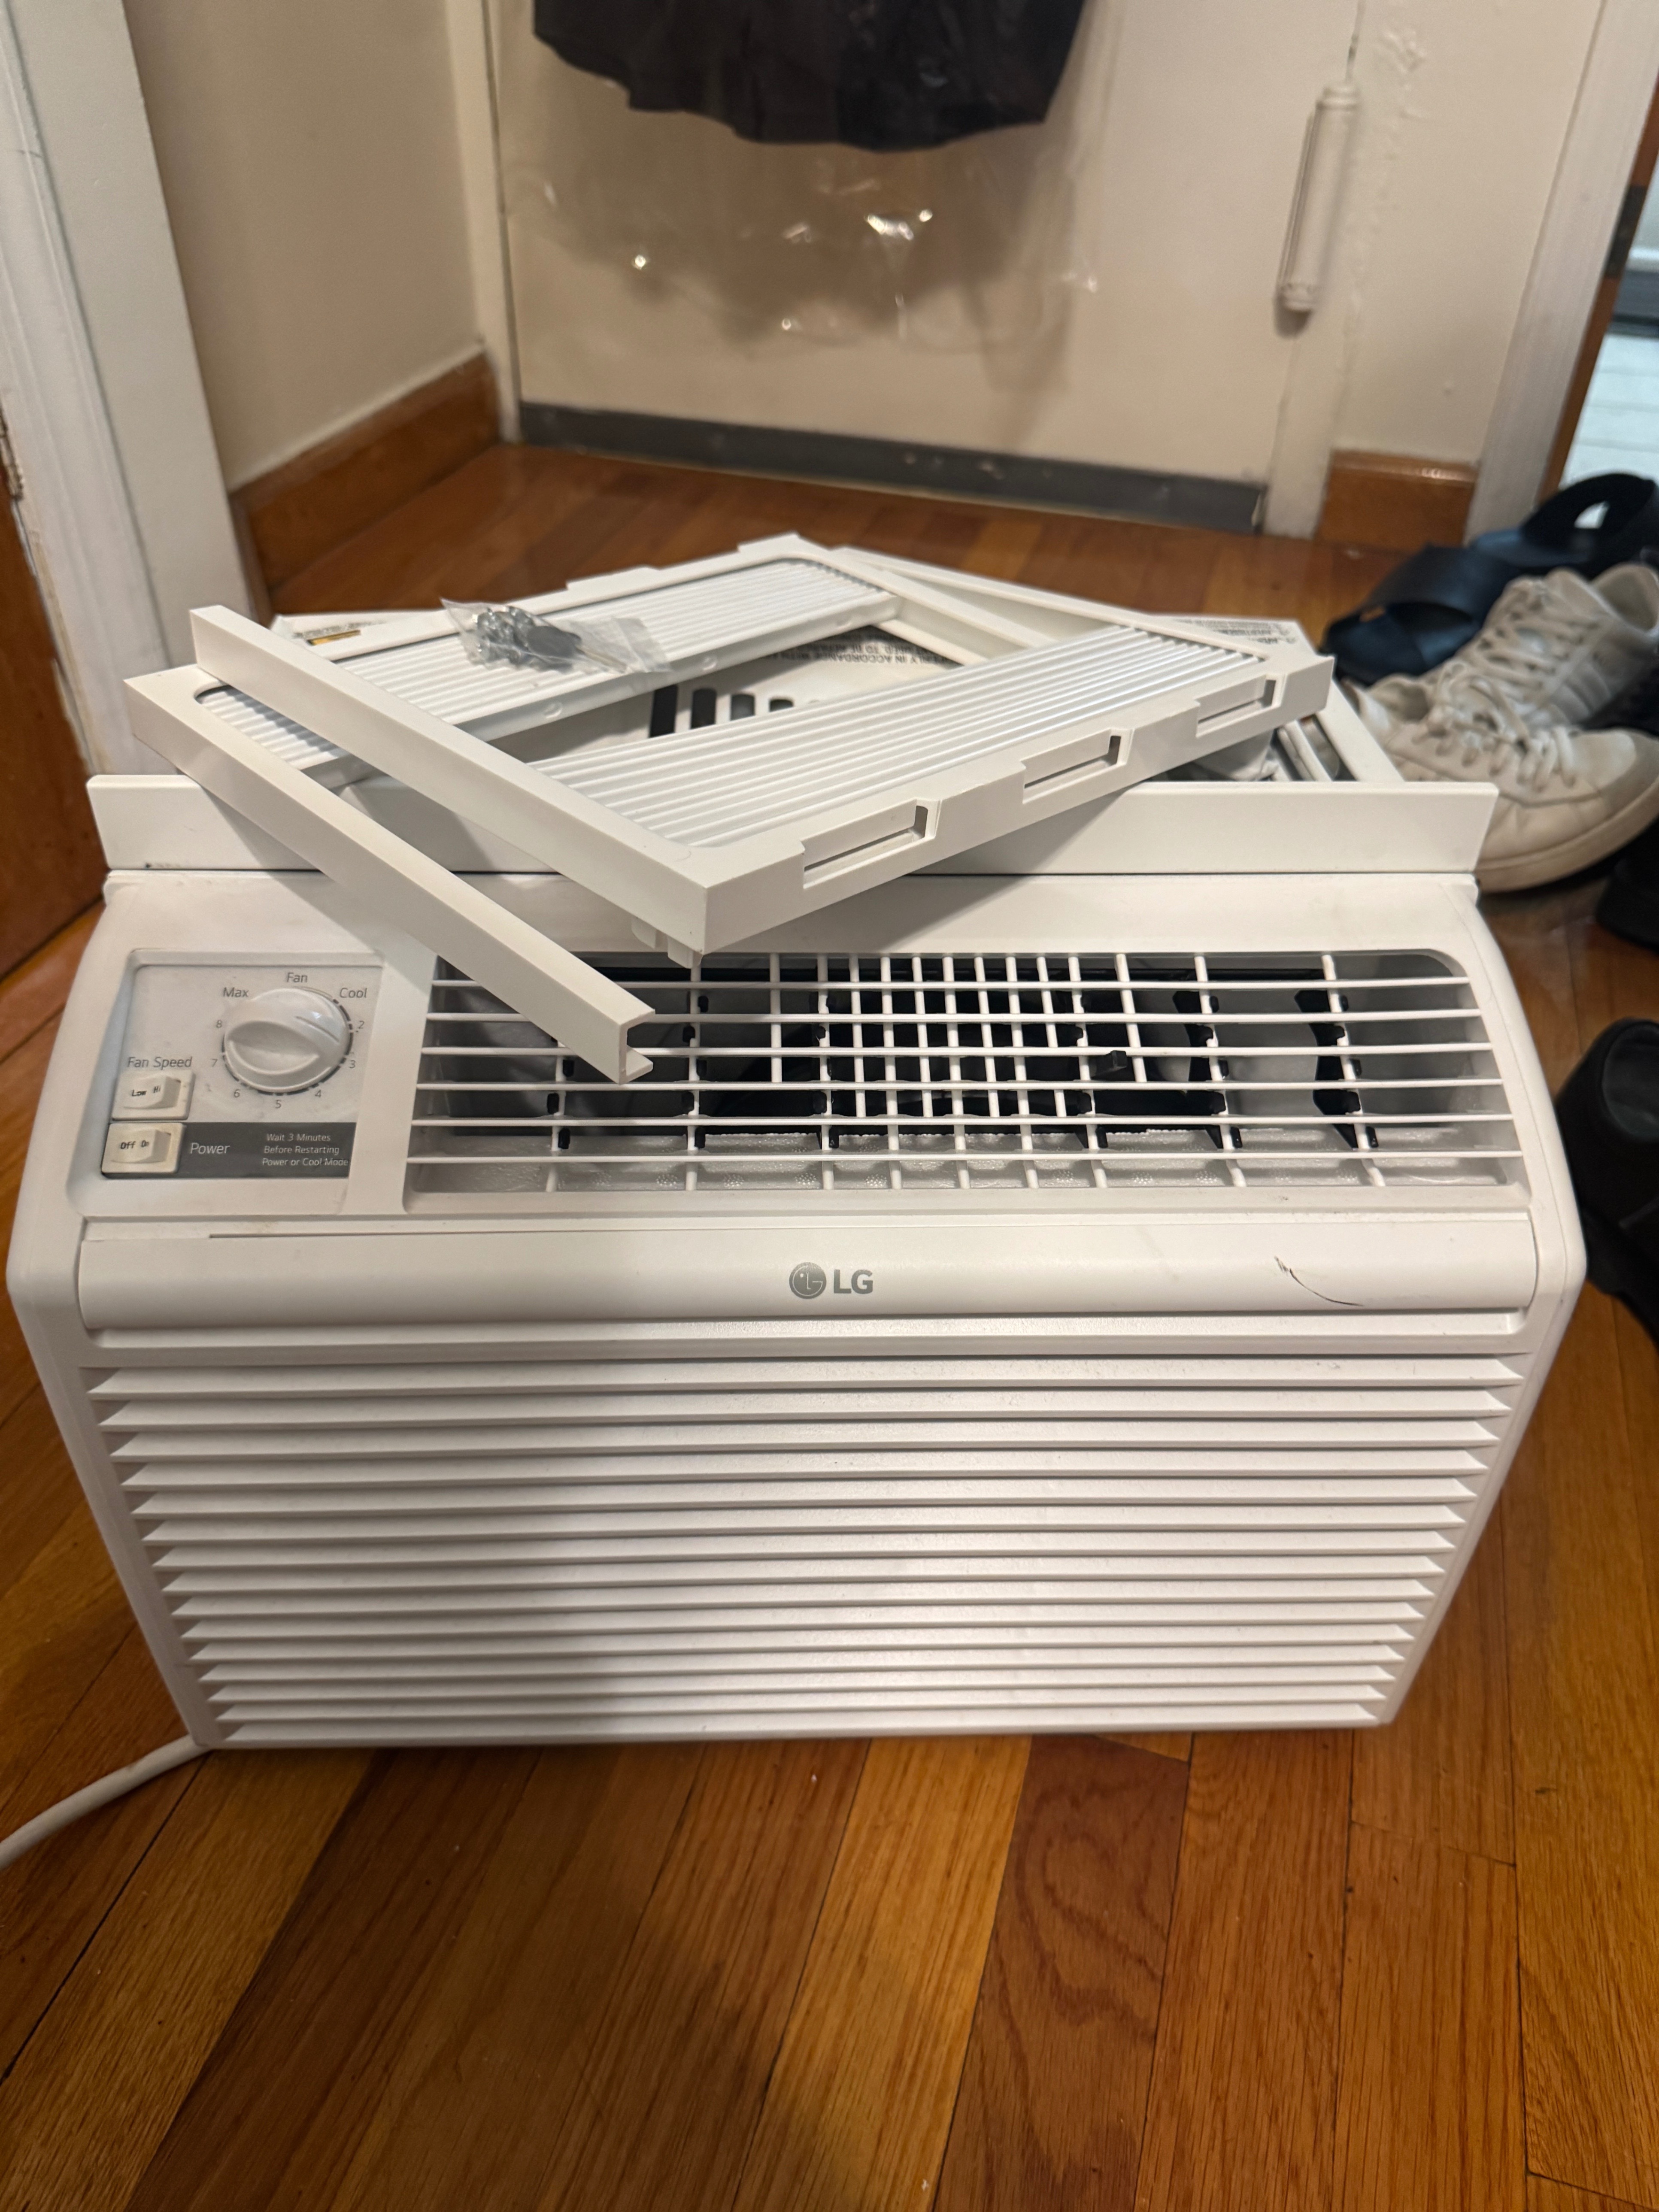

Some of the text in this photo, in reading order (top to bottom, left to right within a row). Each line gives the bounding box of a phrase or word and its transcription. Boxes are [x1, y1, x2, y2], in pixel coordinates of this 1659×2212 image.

[286, 972, 308, 983] Fan
[223, 987, 249, 997] Max
[340, 987, 367, 998] Cool
[216, 1020, 222, 1028] 8
[358, 1021, 365, 1029] 2
[127, 1056, 193, 1070] Fan Speed
[349, 1060, 356, 1068] 3
[153, 1085, 161, 1093] Hi
[234, 1089, 240, 1097] 6
[315, 1089, 321, 1098] 4
[276, 1100, 282, 1108] 5
[288, 1133, 294, 1141] 3
[120, 1141, 136, 1149] Off
[190, 1142, 230, 1154] Power
[264, 1145, 340, 1155] Before Restarting
[262, 1158, 288, 1166] Power
[833, 1269, 873, 1294] LG
